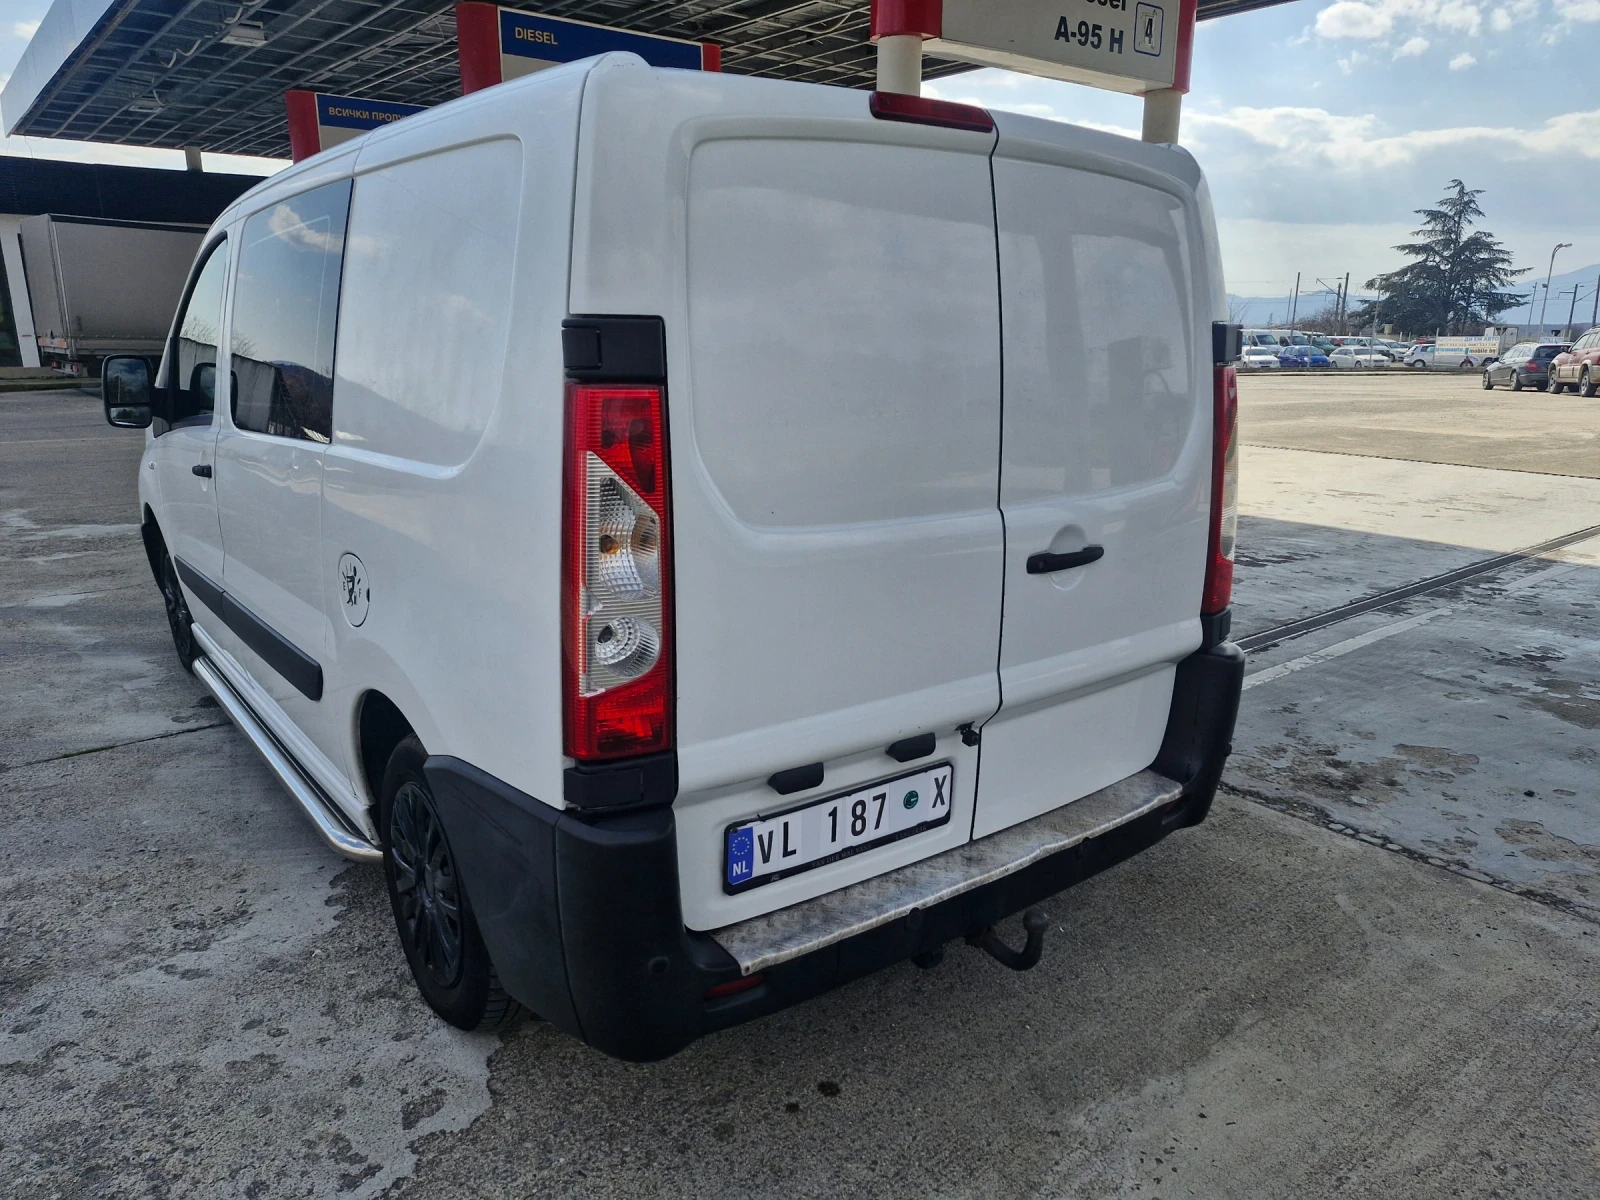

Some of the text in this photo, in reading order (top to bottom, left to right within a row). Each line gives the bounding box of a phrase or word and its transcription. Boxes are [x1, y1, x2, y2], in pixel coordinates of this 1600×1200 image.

[514, 26, 559, 45] DIESEL
[1054, 15, 1124, 54] A-95 H
[328, 106, 370, 119] ВСИЧКИ
[757, 774, 948, 864] VL 187 X
[732, 860, 749, 877] NL
